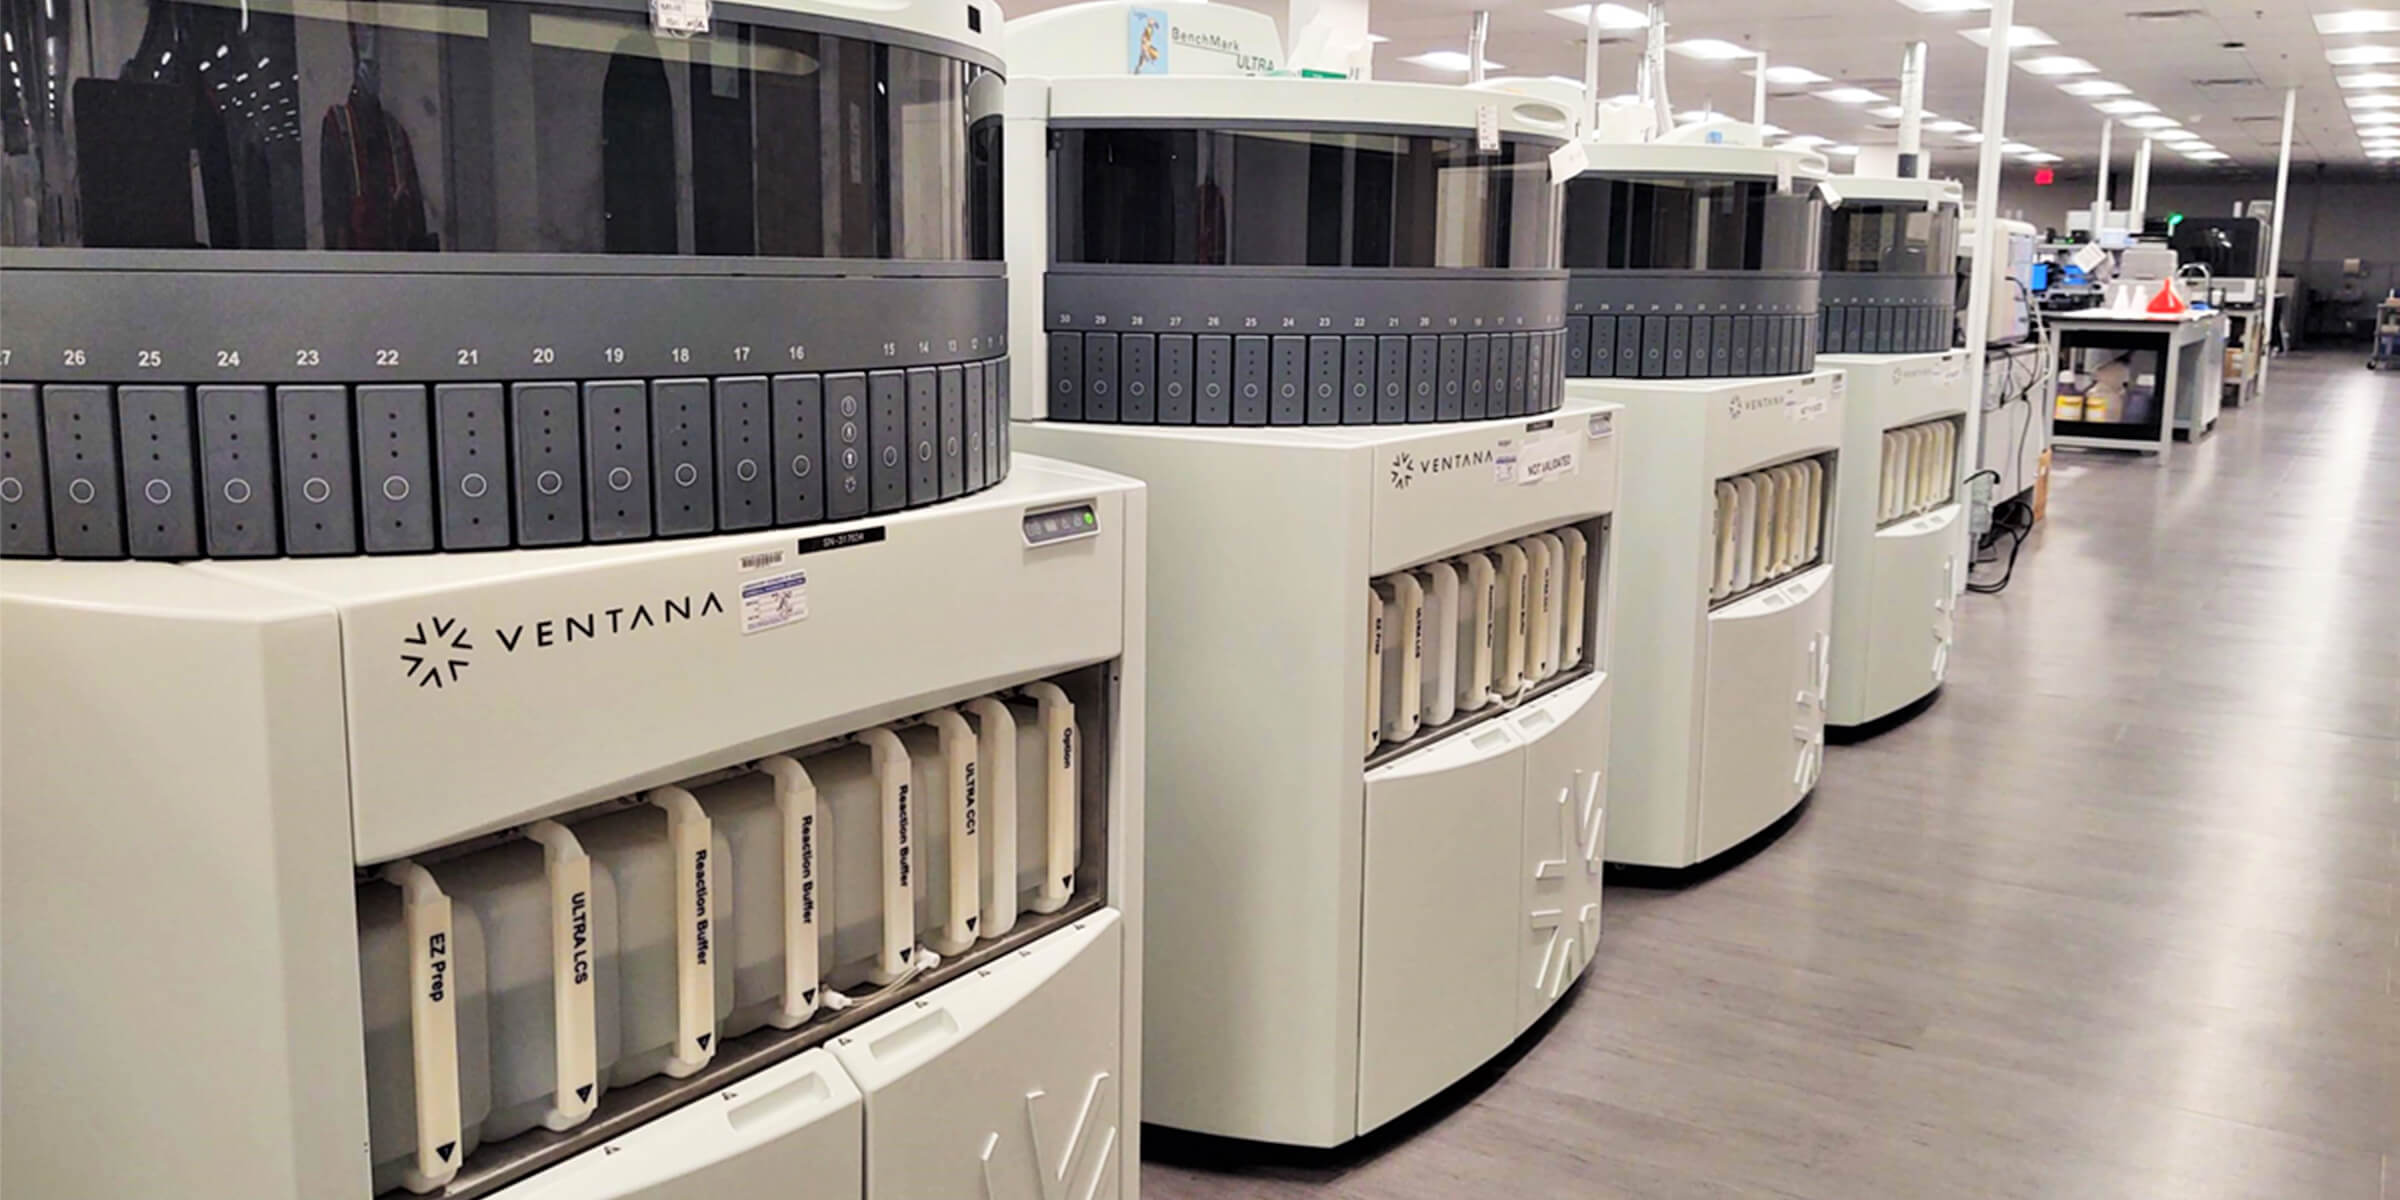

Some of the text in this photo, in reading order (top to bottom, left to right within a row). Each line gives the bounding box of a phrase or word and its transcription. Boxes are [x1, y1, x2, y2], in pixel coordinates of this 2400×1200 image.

[1171, 26, 1239, 50] BenchMark
[1236, 54, 1274, 72] ULTRA
[63, 350, 86, 366] 26
[138, 351, 161, 366] 25
[217, 351, 241, 366] 24
[297, 350, 320, 366] 23
[376, 350, 399, 365] 22
[458, 349, 479, 365] 21
[533, 348, 555, 363] 20
[604, 348, 624, 363] 19
[672, 347, 689, 363] 18
[733, 347, 750, 361] 17
[789, 346, 805, 360] 16
[883, 342, 895, 356] 15
[919, 341, 929, 353] 14
[1420, 450, 1493, 474] VENTANA
[496, 592, 723, 652] VENTANA
[1063, 727, 1072, 769] Option
[965, 763, 975, 836] ULTRA CC1
[899, 784, 909, 887] Reaction Buffer
[802, 815, 813, 924] Reaction Buffer
[571, 891, 589, 985] ULTRA LCS
[695, 849, 709, 965] Reaction Buffer
[429, 933, 446, 1002] EZ Prep
